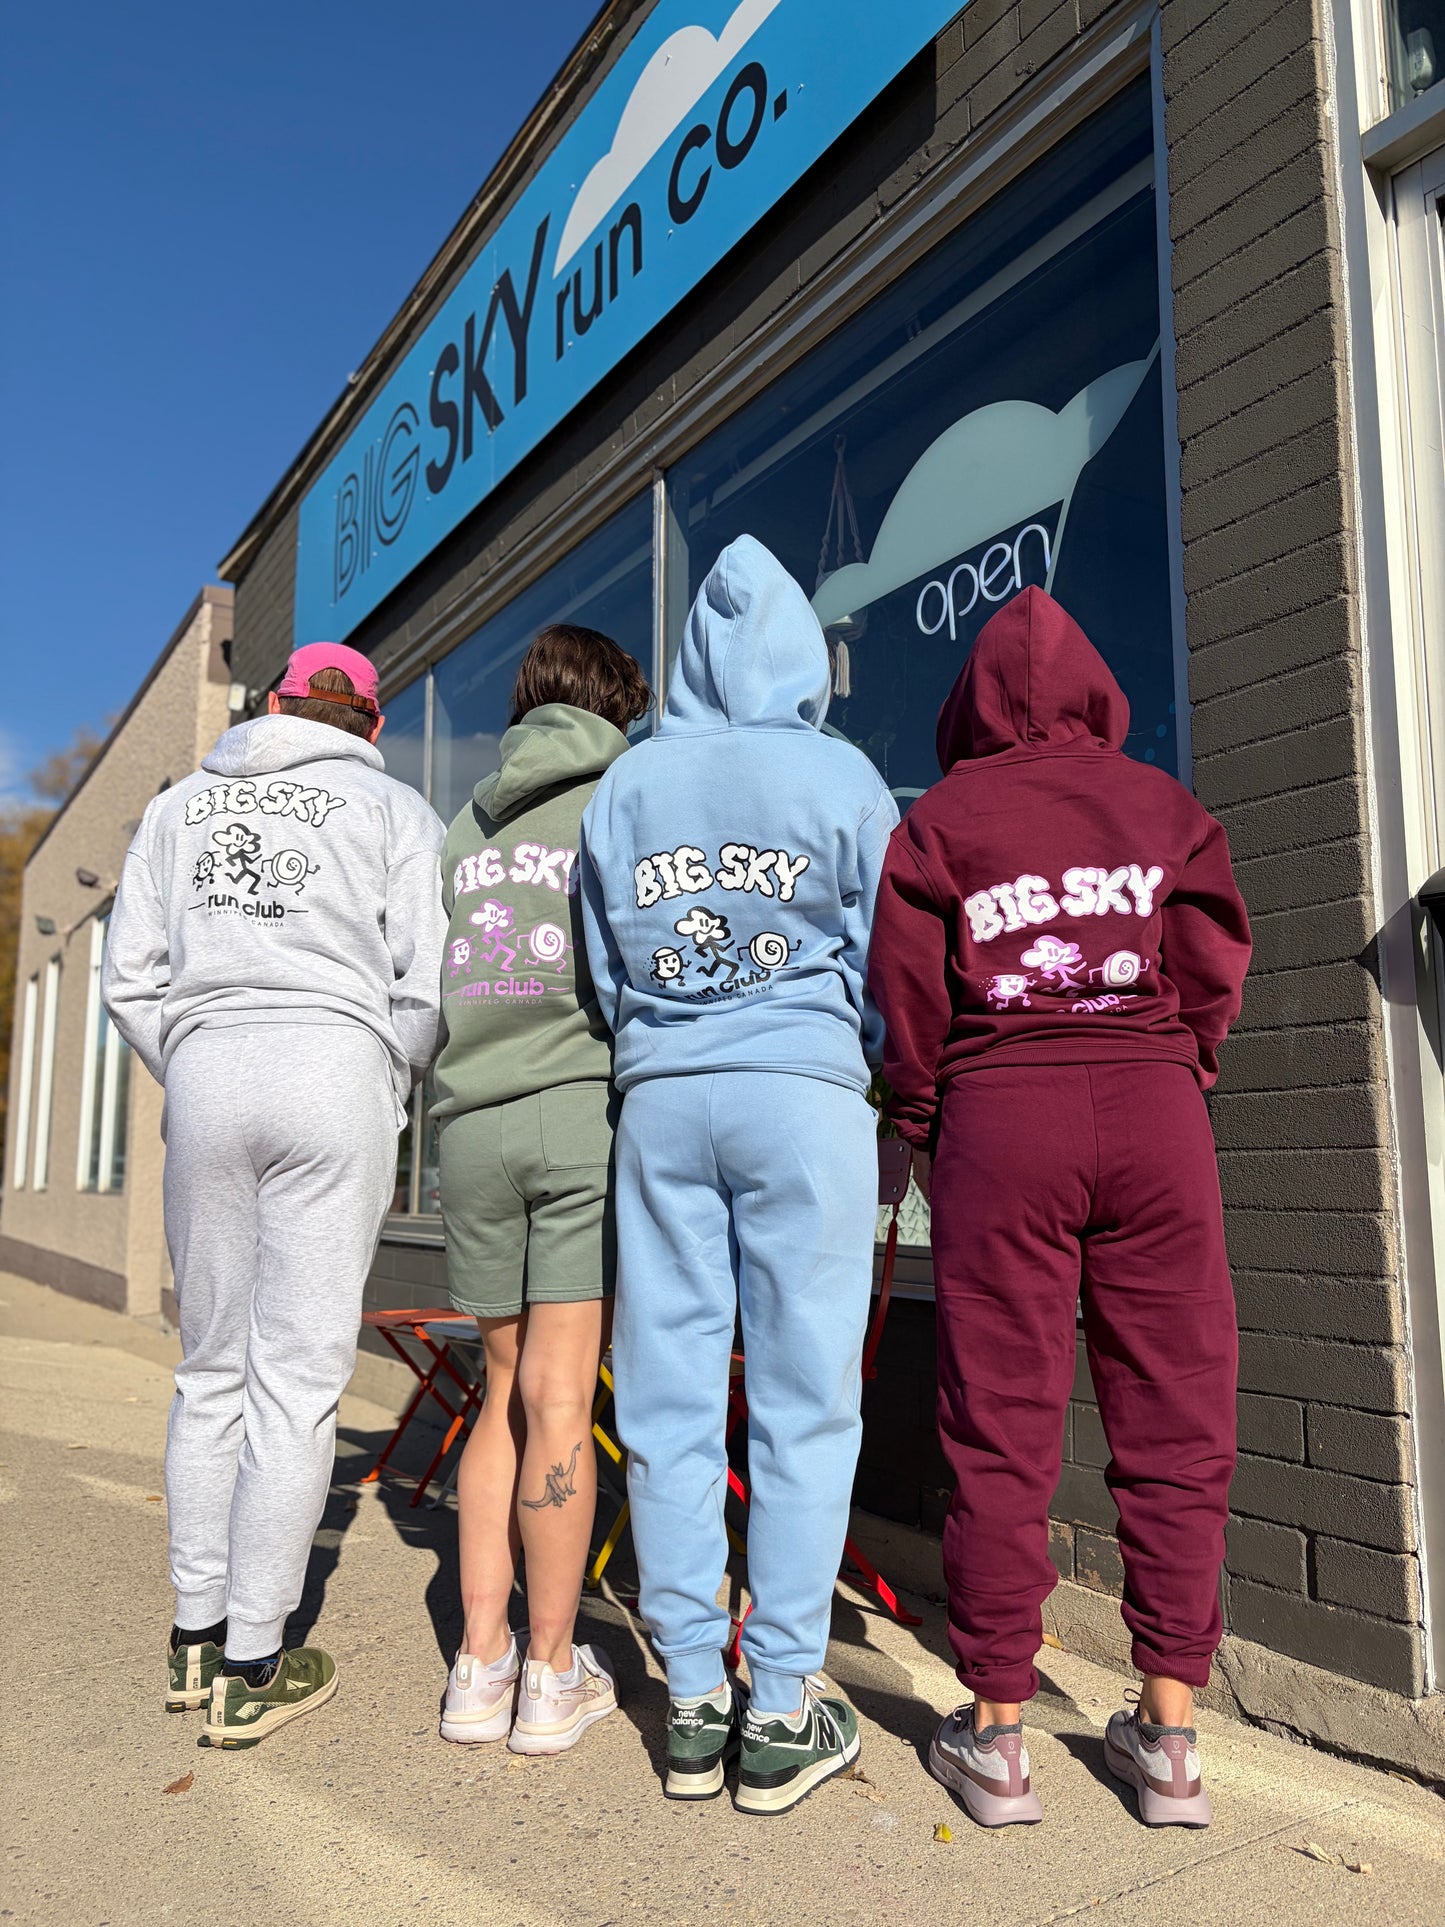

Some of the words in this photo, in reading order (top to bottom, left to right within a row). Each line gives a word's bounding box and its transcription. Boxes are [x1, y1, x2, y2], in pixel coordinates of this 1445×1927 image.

[333, 402, 420, 604] BIG
[425, 212, 552, 495] SKY
[555, 202, 643, 362] run
[667, 61, 788, 225] co.
[916, 523, 1051, 641] open
[185, 780, 258, 826] BIG
[259, 781, 346, 828] SKY
[634, 844, 715, 909] BIG
[715, 842, 811, 903] SKY
[208, 894, 240, 909] run
[242, 900, 285, 918] club
[963, 873, 1060, 943] BIG
[1060, 863, 1164, 918] SKY
[251, 919, 285, 928] CANADA
[460, 981, 490, 998] run
[494, 976, 545, 996] club
[719, 969, 772, 994] club
[736, 984, 774, 999] CANADA
[504, 998, 543, 1006] CANADA
[671, 1716, 705, 1727] balance
[678, 1709, 696, 1718] new
[746, 1722, 763, 1734] new
